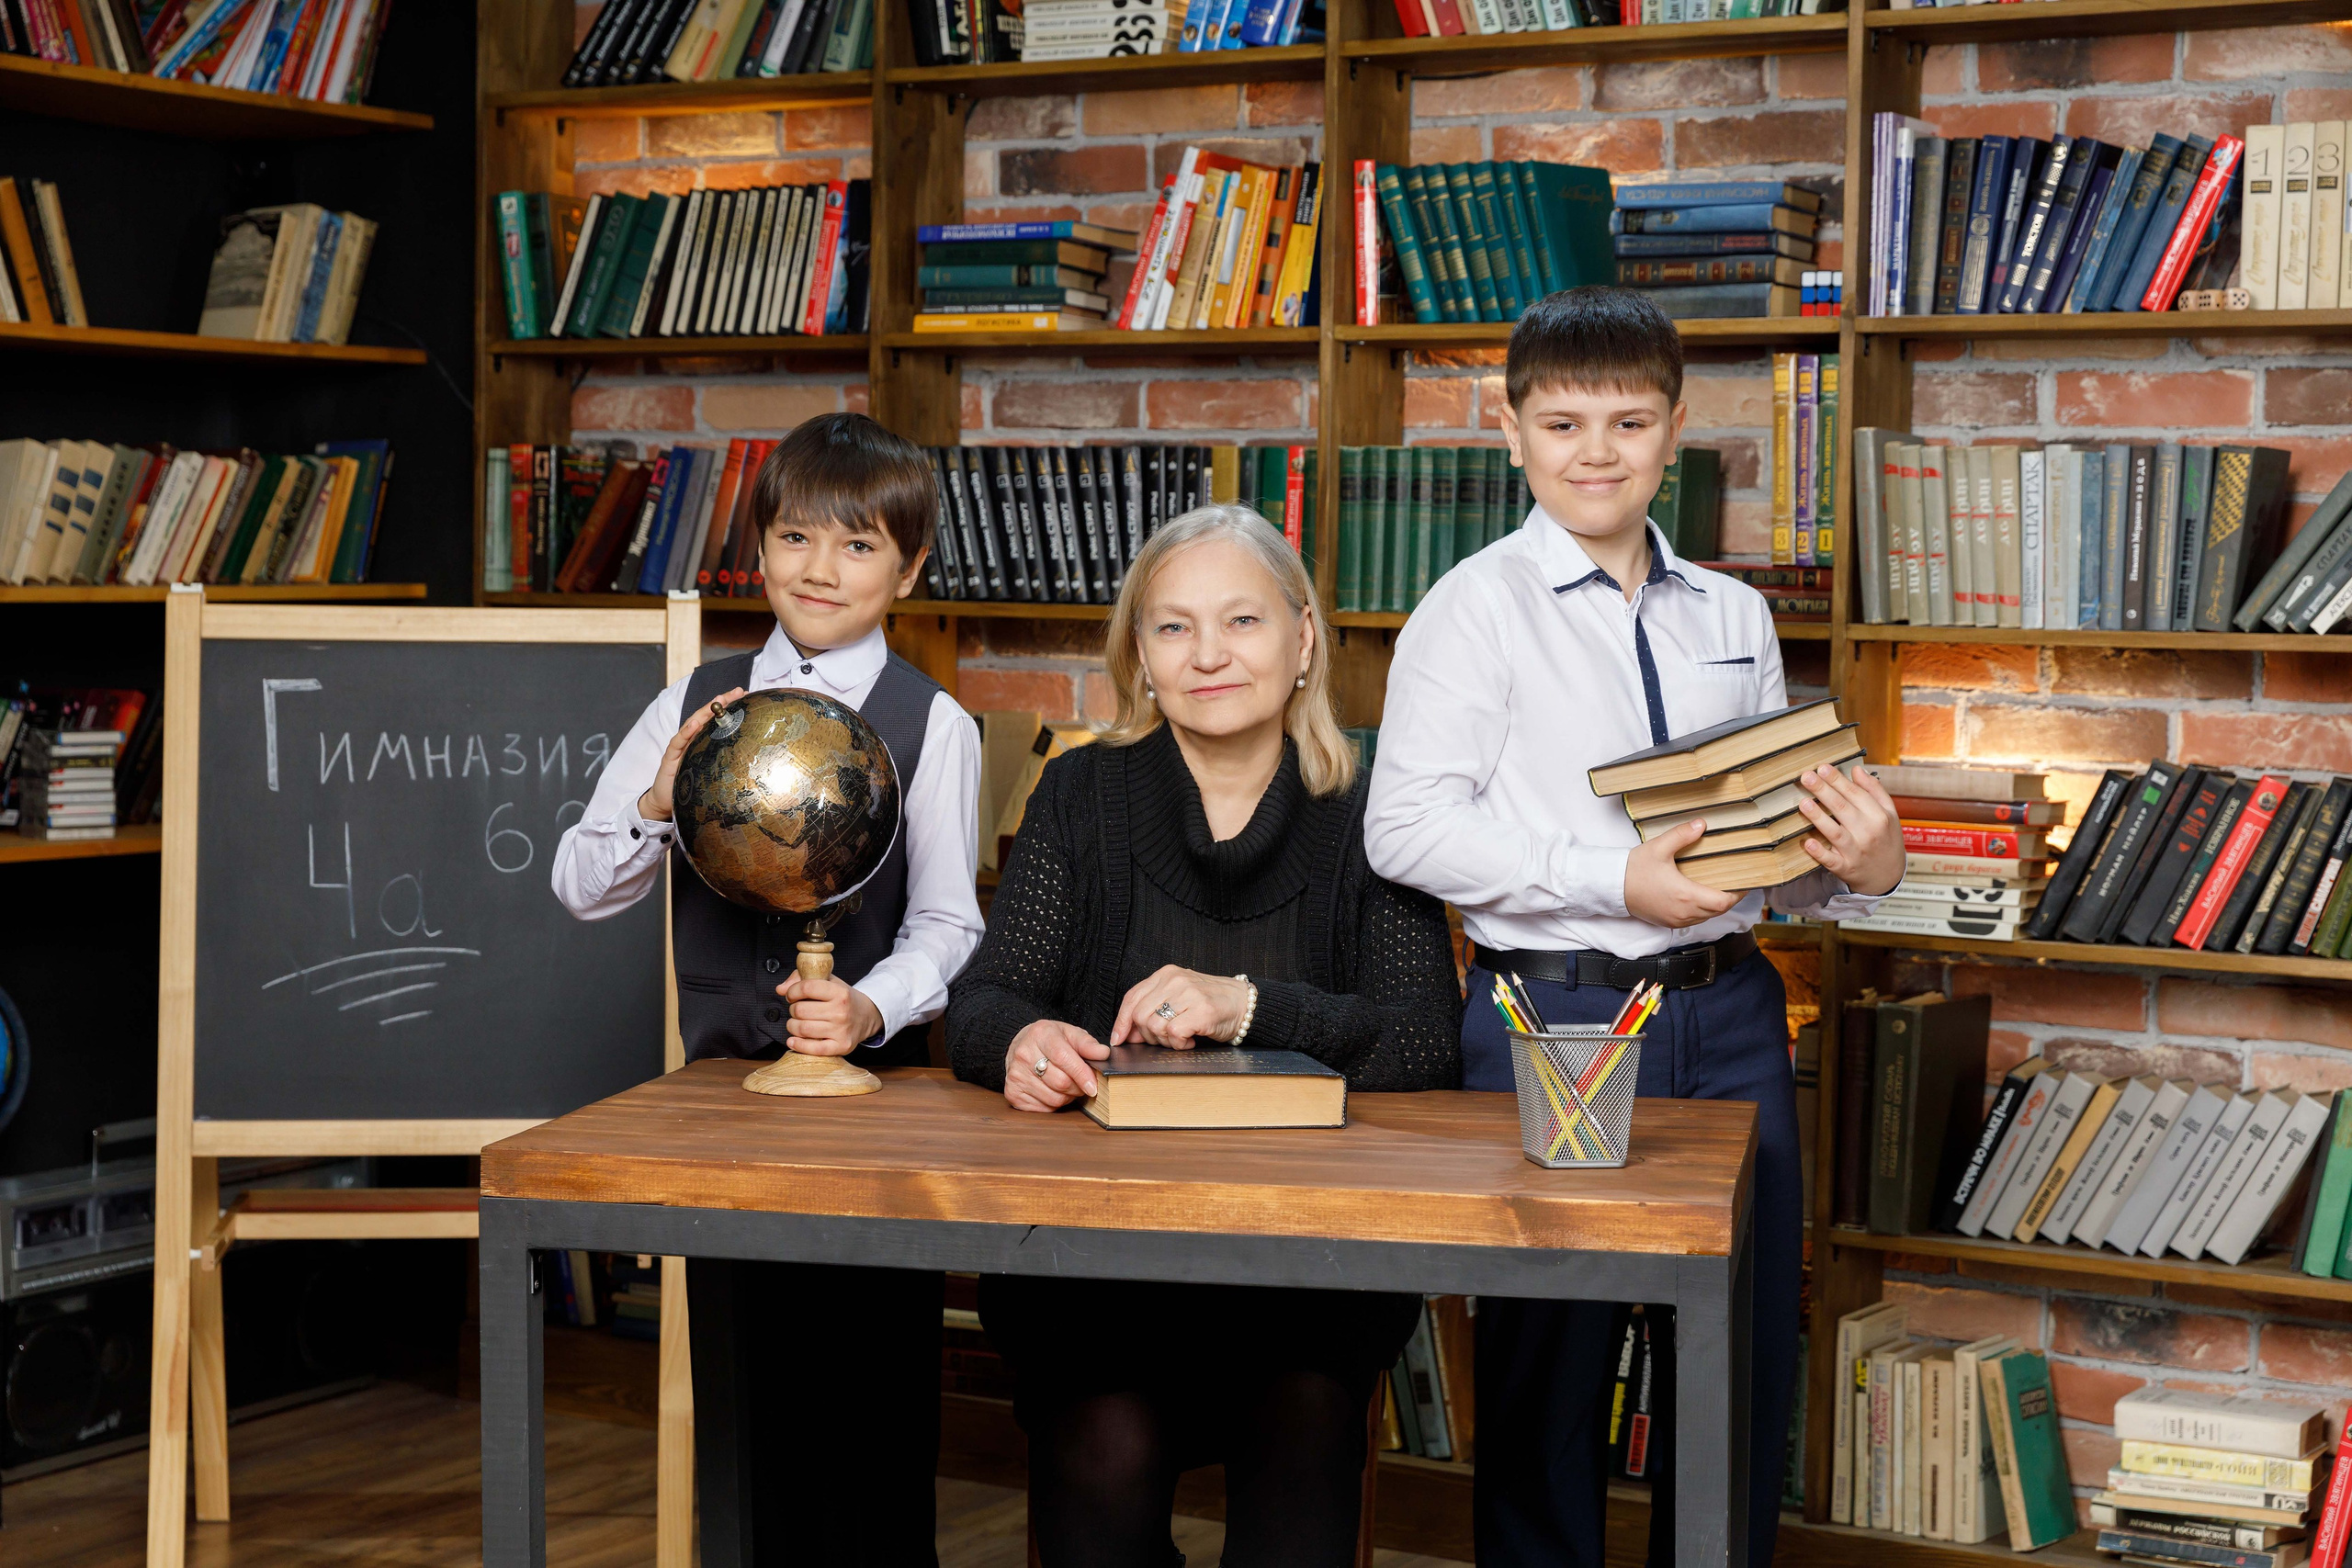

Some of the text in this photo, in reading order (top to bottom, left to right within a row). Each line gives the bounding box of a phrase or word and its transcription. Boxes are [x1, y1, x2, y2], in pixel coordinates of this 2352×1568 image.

[2252, 147, 2272, 177] 1
[2288, 145, 2309, 175] 2
[2318, 141, 2339, 172] 3
[1797, 417, 1808, 508] Жизнь животных
[1820, 415, 1832, 506] Жизнь животных
[1778, 531, 1786, 547] 3
[1798, 532, 1808, 552] 2
[1822, 532, 1830, 548] 1
[2023, 461, 2040, 550] СПАРТАК
[263, 678, 610, 792] Гимназия
[1927, 835, 1973, 846] ЗВЯГИНЦЕВ
[2097, 853, 2126, 897] НОРМАН
[2120, 805, 2149, 851] МЕЙЛЕР
[2166, 903, 2185, 925] Ник
[2203, 795, 2241, 855] ИЗБРАННОЕ
[2198, 820, 2255, 908] ВАСИЛИЙ ЗВЯГИНЦЕВ
[1951, 1113, 2003, 1205] ВСТРЕЧИ ВО МРАКЕ
[2315, 1454, 2350, 1551] ВАСИЛИЙ ЗВЯГИНЦЕВ
